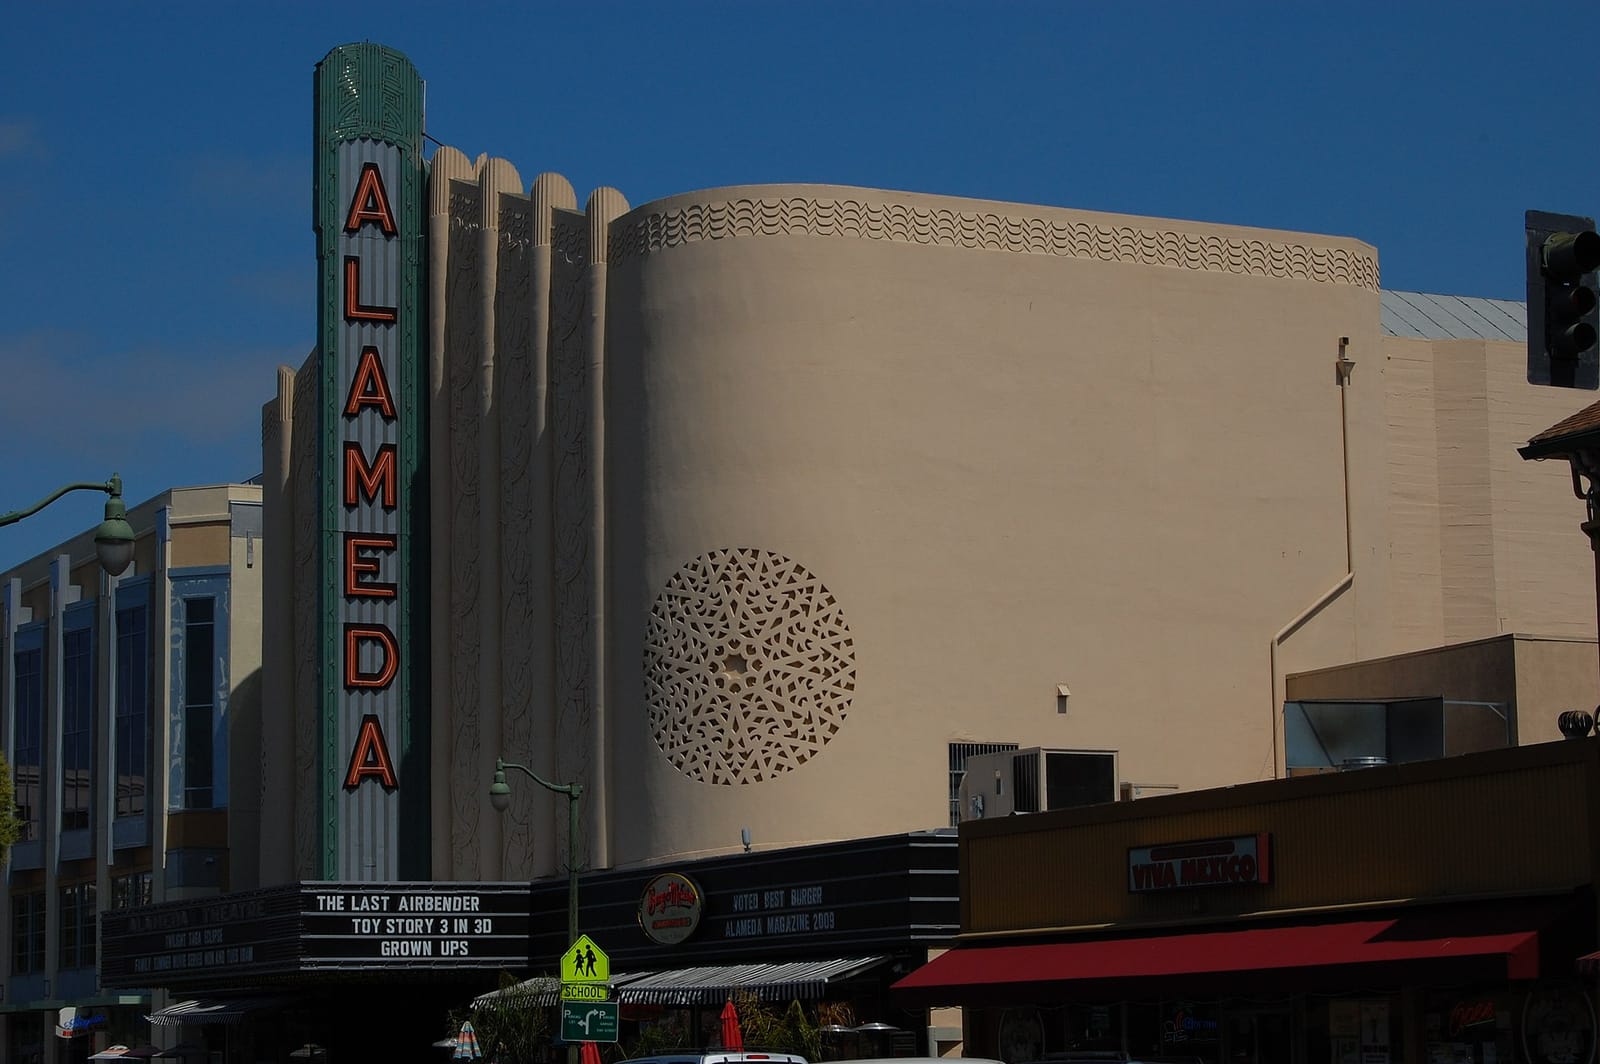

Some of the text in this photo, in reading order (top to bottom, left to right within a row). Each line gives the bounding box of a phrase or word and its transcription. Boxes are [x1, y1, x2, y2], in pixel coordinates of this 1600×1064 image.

[342, 162, 400, 792] ALAMEDA
[1132, 854, 1256, 889] VIVA MEXICO
[316, 895, 480, 912] THE LAST AIRBENDER
[732, 886, 823, 912] VOTED BEST BURGER
[351, 918, 492, 934] TOY STORY 3 IN 3D
[725, 911, 836, 937] ALAMEDA MAGAZINE 2009
[380, 940, 469, 957] GROWN UPS
[565, 986, 602, 998] SCHOOL
